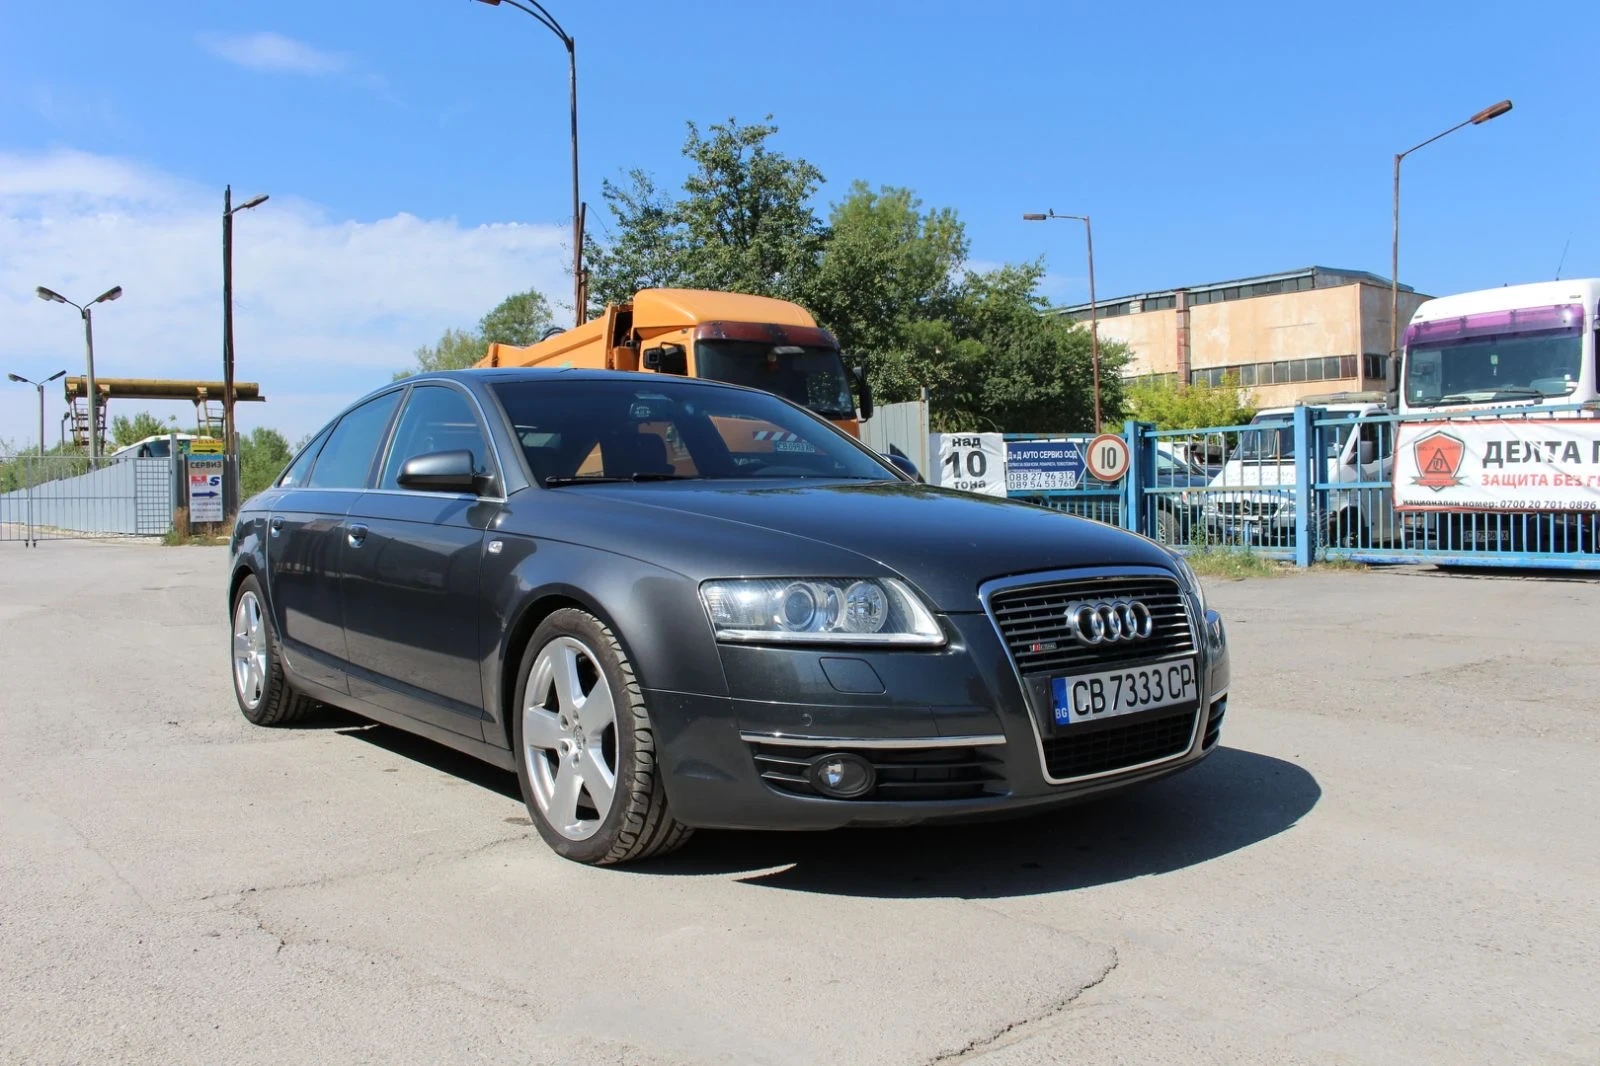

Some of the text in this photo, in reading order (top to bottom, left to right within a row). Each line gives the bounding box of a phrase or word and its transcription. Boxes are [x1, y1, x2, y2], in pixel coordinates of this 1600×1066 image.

[952, 437, 982, 448] над
[1022, 450, 1039, 459] АУТО
[1039, 450, 1063, 459] СЕРВИЗ
[1101, 447, 1117, 469] 10
[1482, 440, 1582, 468] ДЕЛТА
[190, 461, 222, 469] СЕРВИЗ
[945, 450, 987, 478] 10
[1009, 471, 1074, 482] 088 27 96 312
[1481, 474, 1548, 488] ЗАЩИТА
[1553, 474, 1583, 487] БЕЗ
[953, 480, 987, 489] тона
[1009, 481, 1028, 489] 089
[1044, 480, 1056, 488] 53
[1059, 480, 1075, 488] 760
[1500, 499, 1528, 508] 0700
[1528, 500, 1543, 509] 20
[1569, 500, 1597, 510] 0896
[1072, 664, 1193, 716] CB 7333 CP
[1054, 707, 1068, 720] BG
